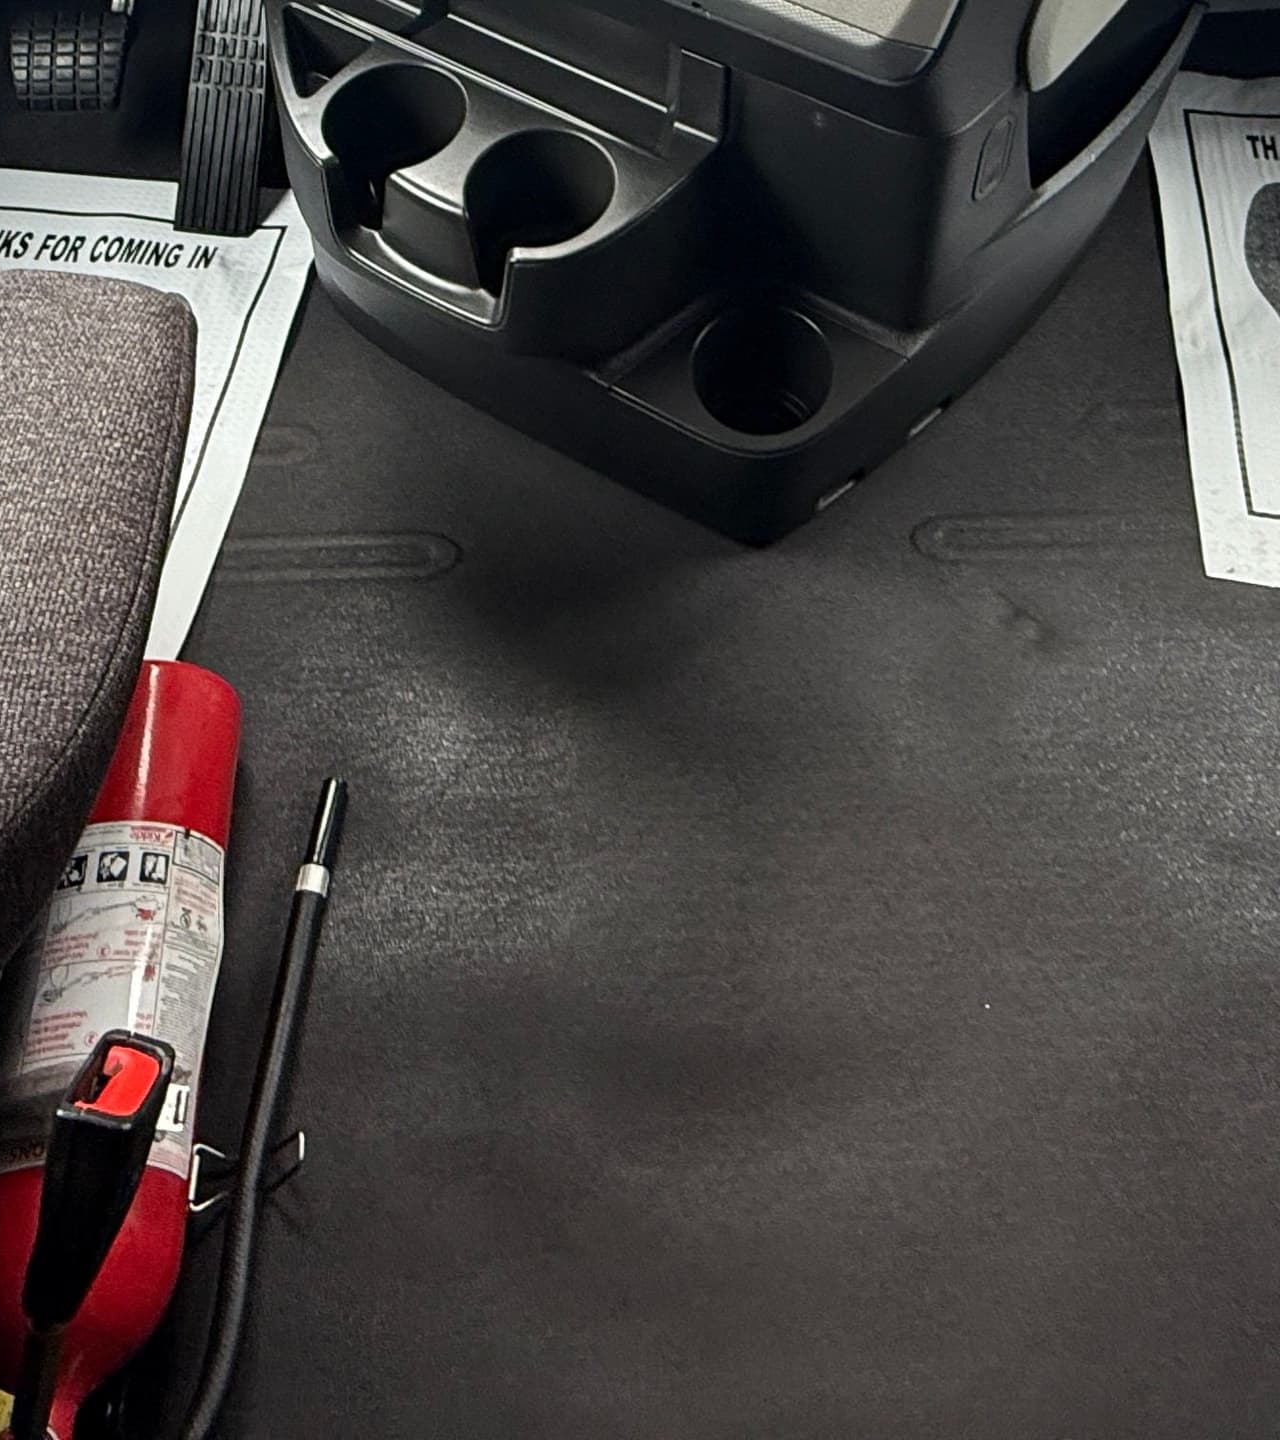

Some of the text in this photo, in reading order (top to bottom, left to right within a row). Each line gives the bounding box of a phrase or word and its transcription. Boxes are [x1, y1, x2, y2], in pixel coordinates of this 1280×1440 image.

[34, 234, 87, 264] FOR
[89, 234, 185, 268] COMING
[187, 244, 219, 270] IN
